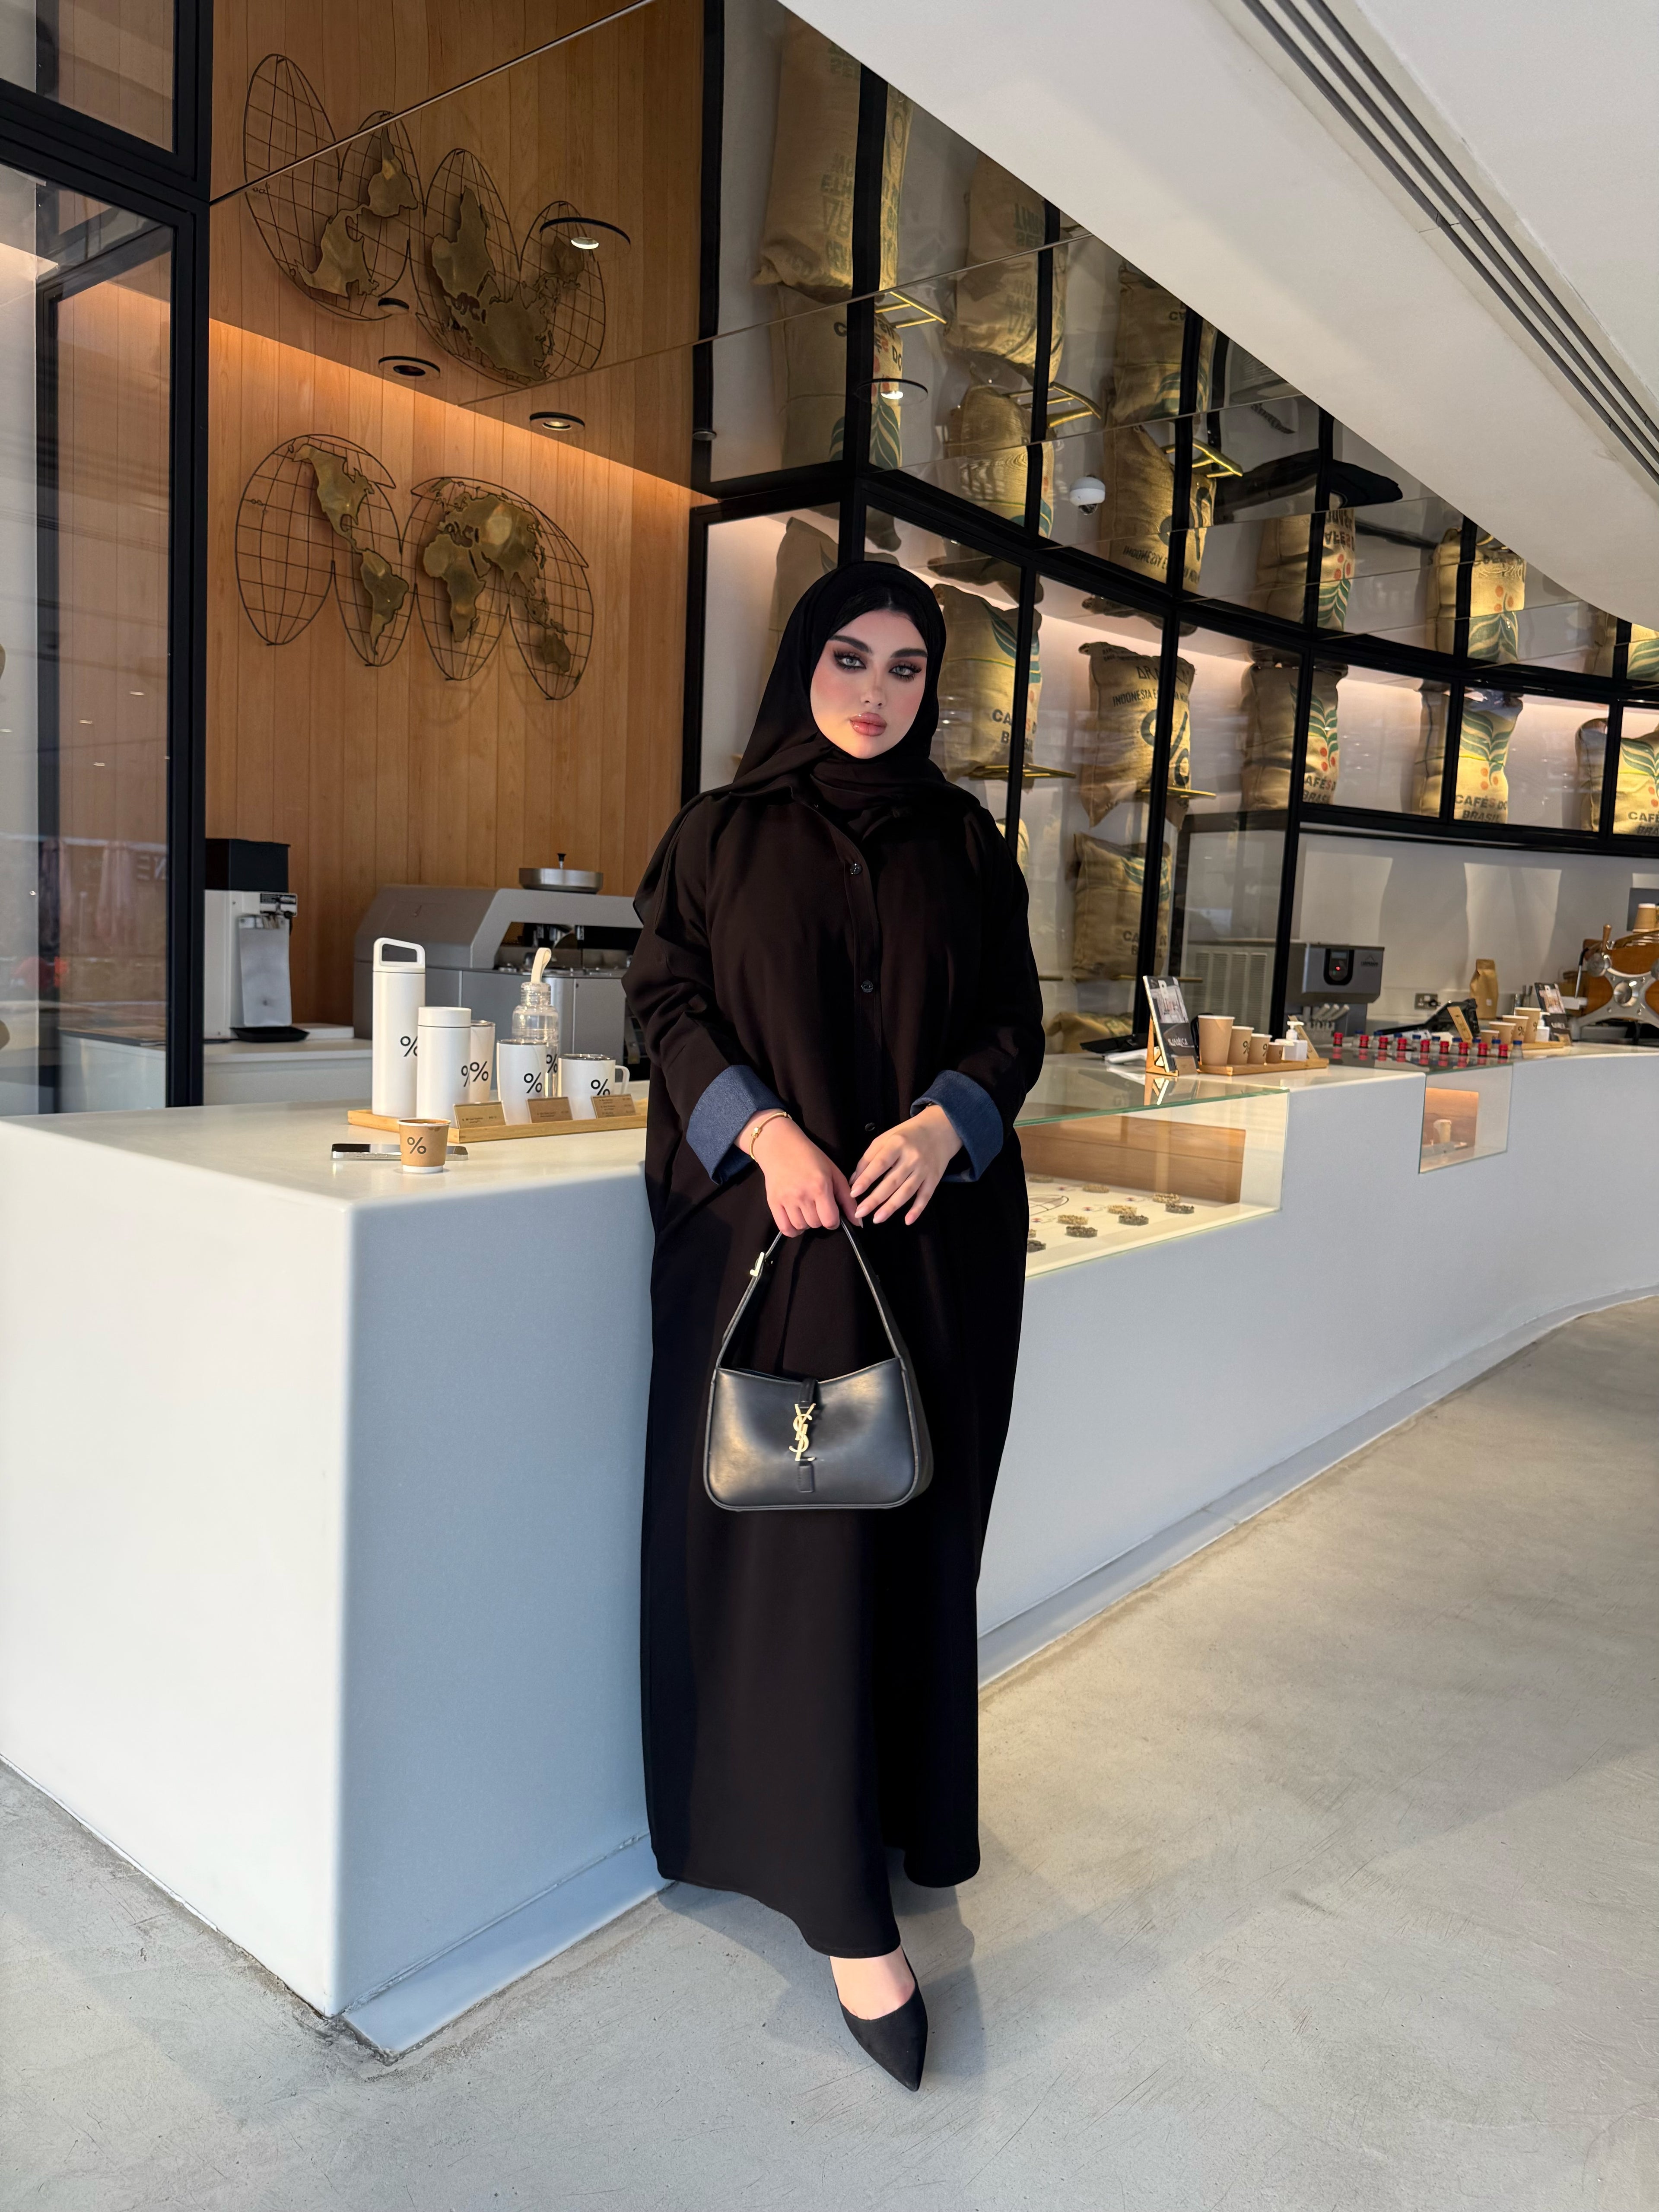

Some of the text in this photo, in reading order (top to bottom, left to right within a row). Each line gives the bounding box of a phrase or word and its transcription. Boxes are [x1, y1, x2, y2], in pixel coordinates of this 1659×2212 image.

[1112, 689, 1151, 707] INDONESIA
[1304, 775, 1332, 790] AFÉS
[1455, 795, 1496, 809] CAFÉS
